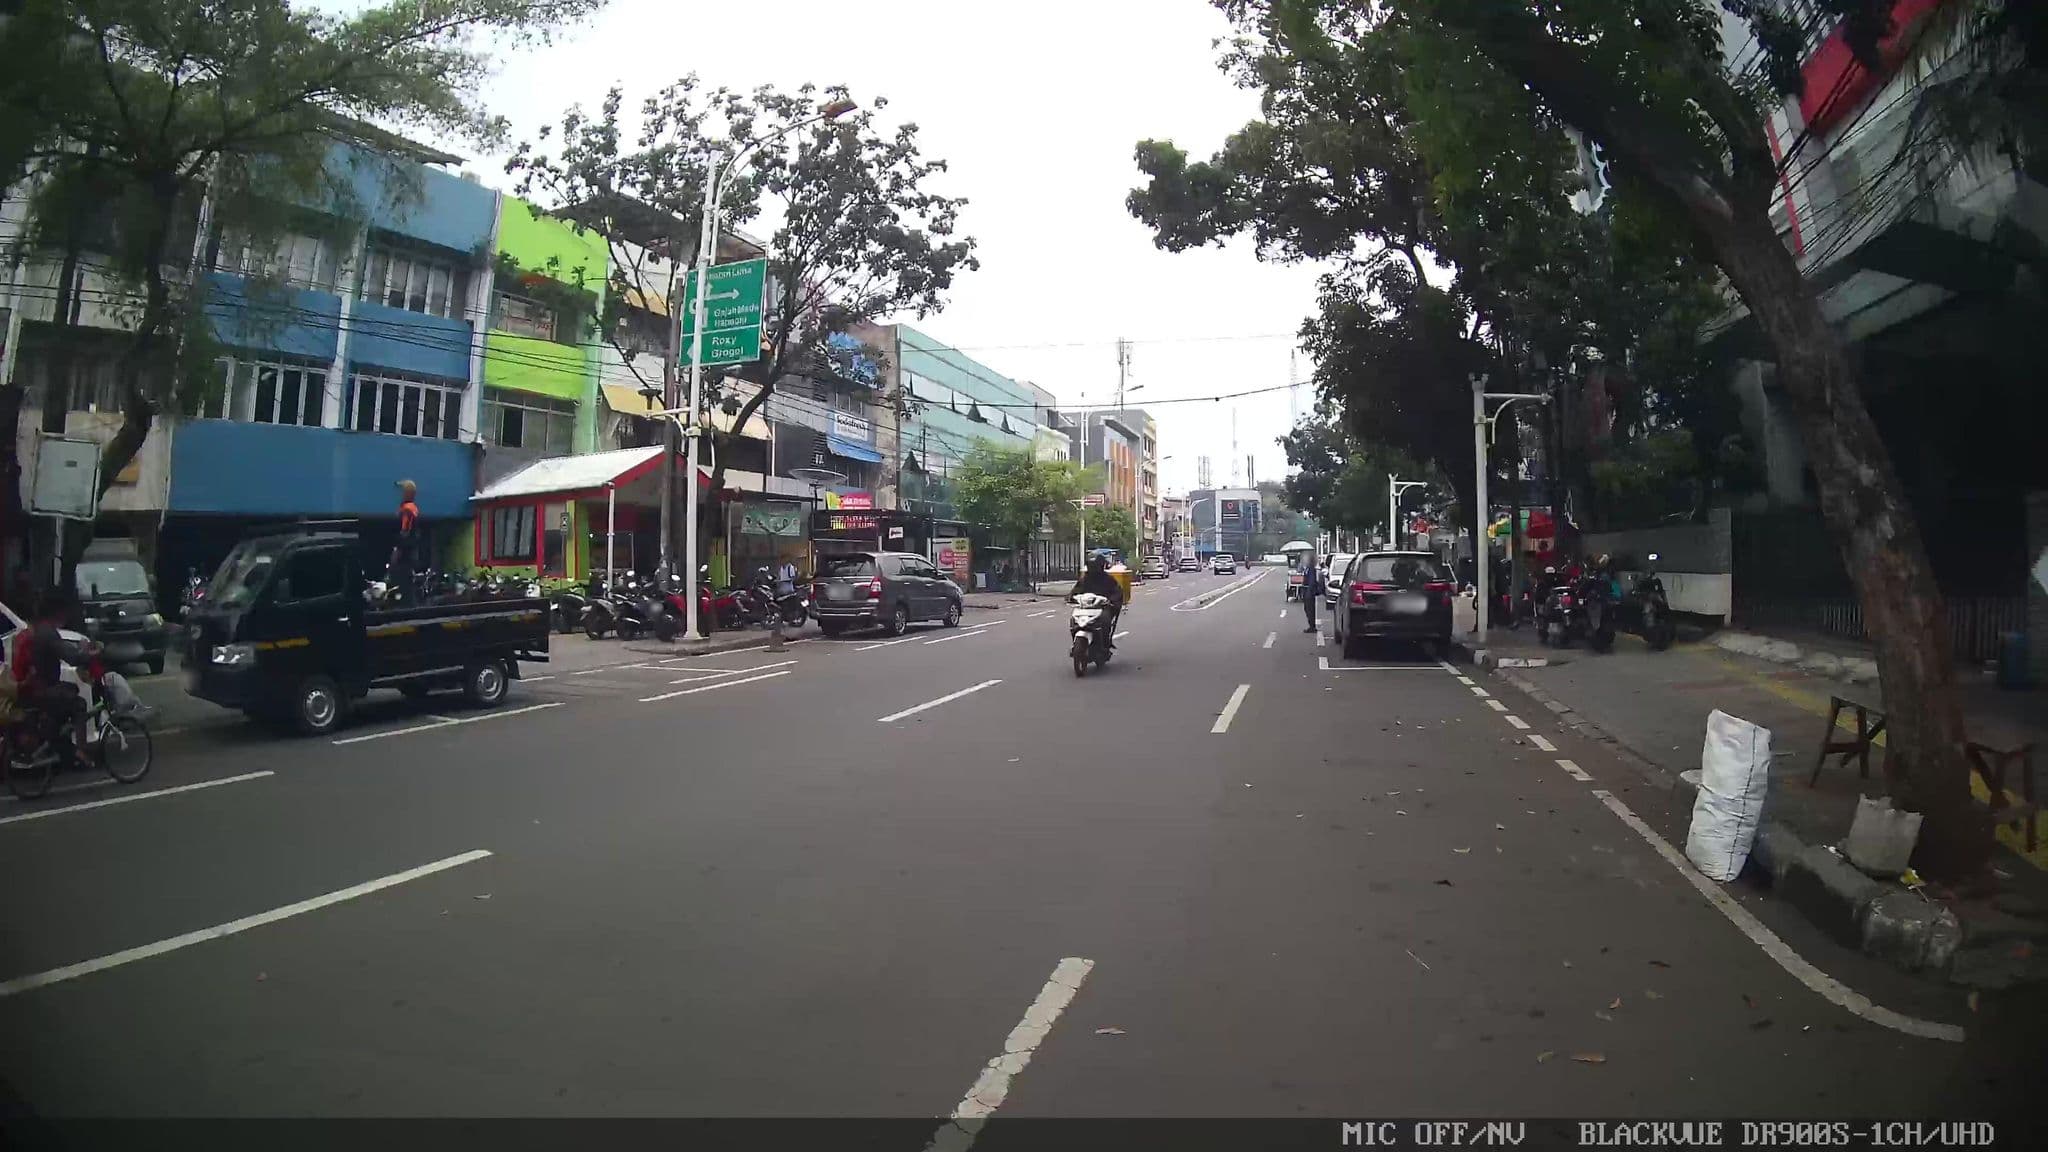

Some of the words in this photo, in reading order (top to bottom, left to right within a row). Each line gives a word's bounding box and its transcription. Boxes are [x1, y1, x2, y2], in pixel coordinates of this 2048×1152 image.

[714, 306, 737, 317] Gajah
[712, 336, 737, 346] Roxy
[712, 346, 744, 358] Grogol
